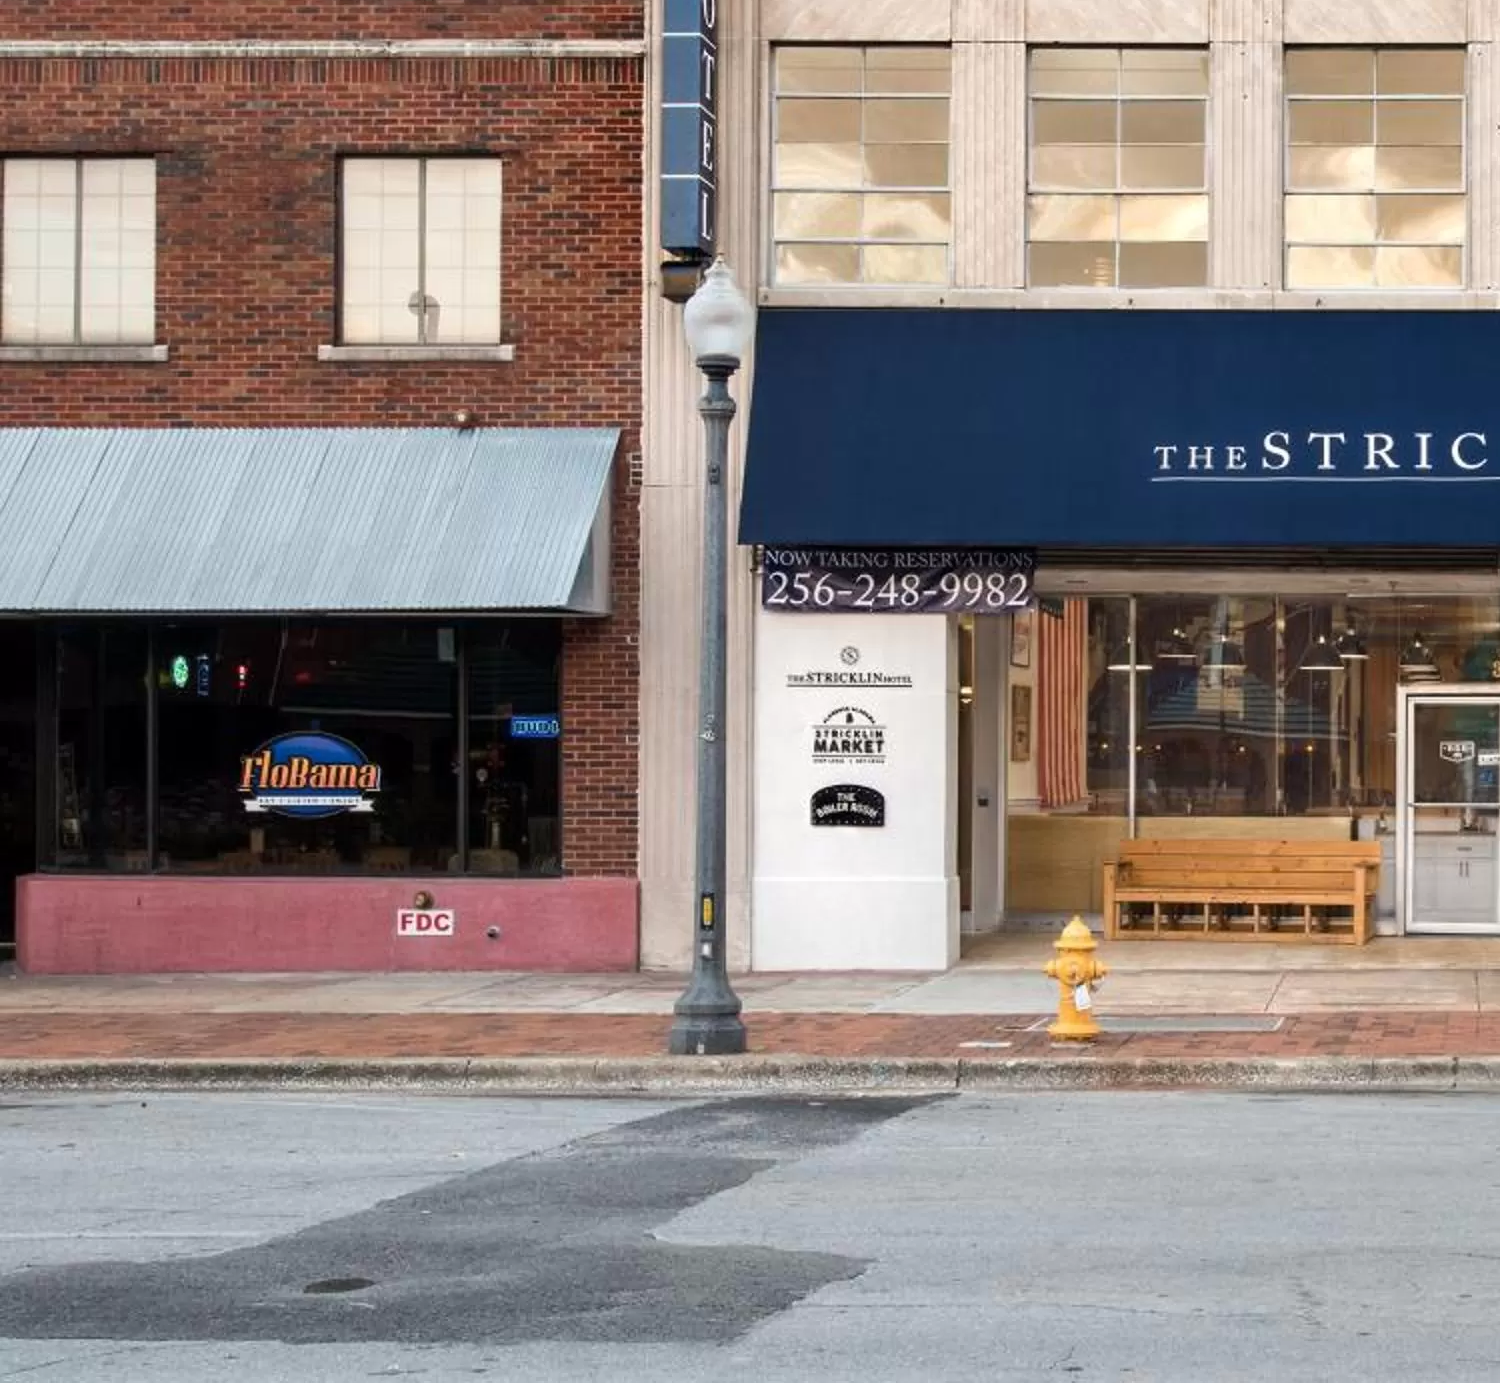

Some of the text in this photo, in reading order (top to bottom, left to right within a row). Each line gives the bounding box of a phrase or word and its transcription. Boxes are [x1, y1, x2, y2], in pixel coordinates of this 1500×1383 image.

[1153, 445, 1248, 470] THE
[765, 550, 1034, 568] NOW TAKING RESERVATIONS
[767, 571, 1030, 607] 256-248-9982
[806, 672, 884, 684] STRICKLIN
[813, 739, 886, 754] MARKET
[238, 749, 381, 792] FloBama
[401, 913, 450, 931] FDC
